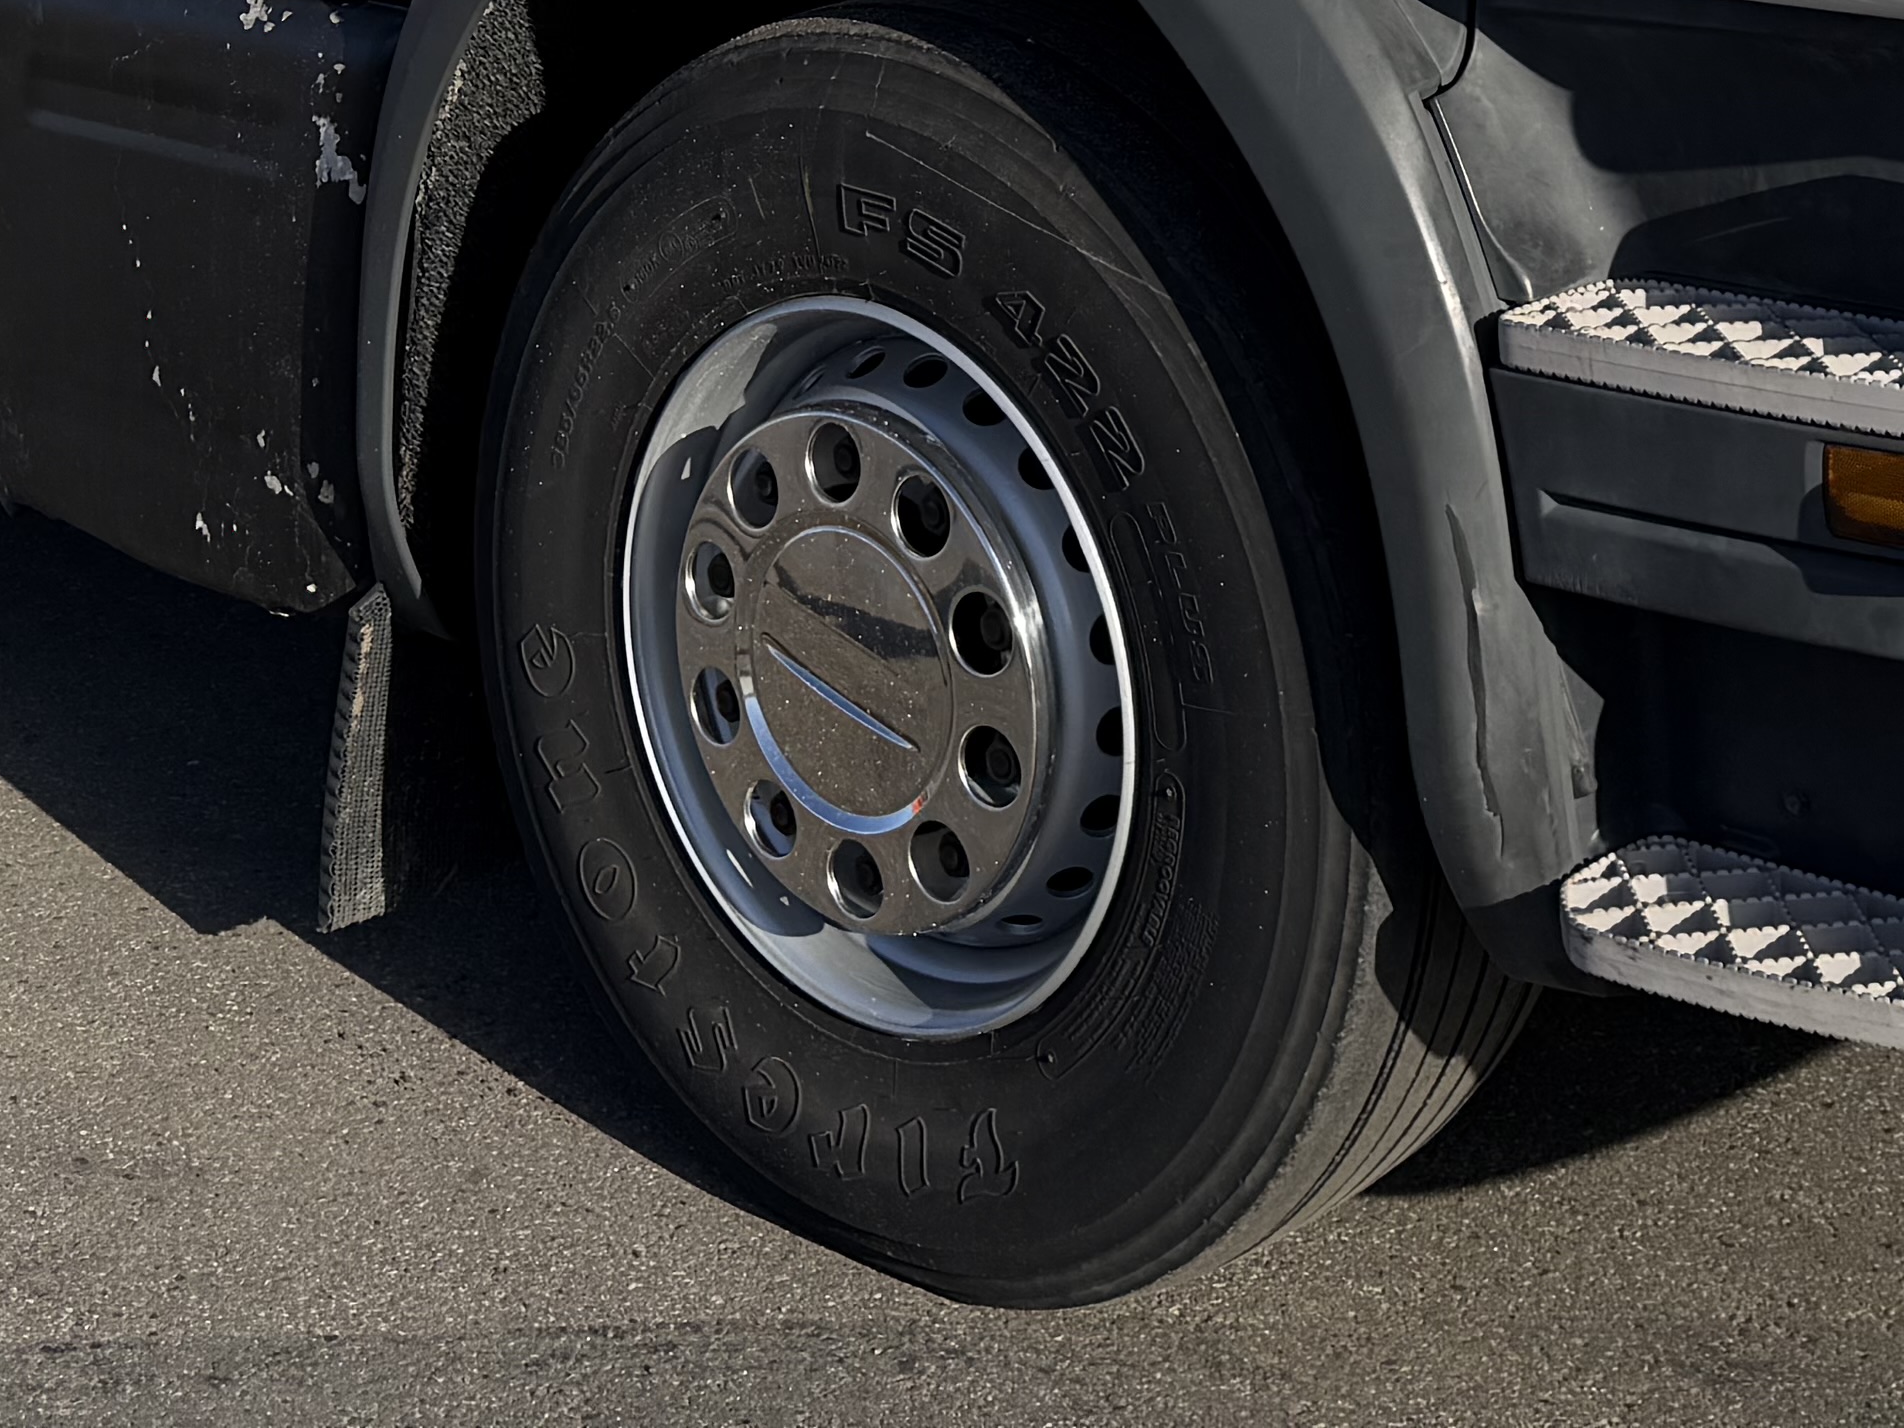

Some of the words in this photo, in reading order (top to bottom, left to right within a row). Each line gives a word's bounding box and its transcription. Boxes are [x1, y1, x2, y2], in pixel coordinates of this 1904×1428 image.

[838, 182, 966, 278] FS
[993, 289, 1145, 492] 422
[1146, 500, 1214, 685] PLUS
